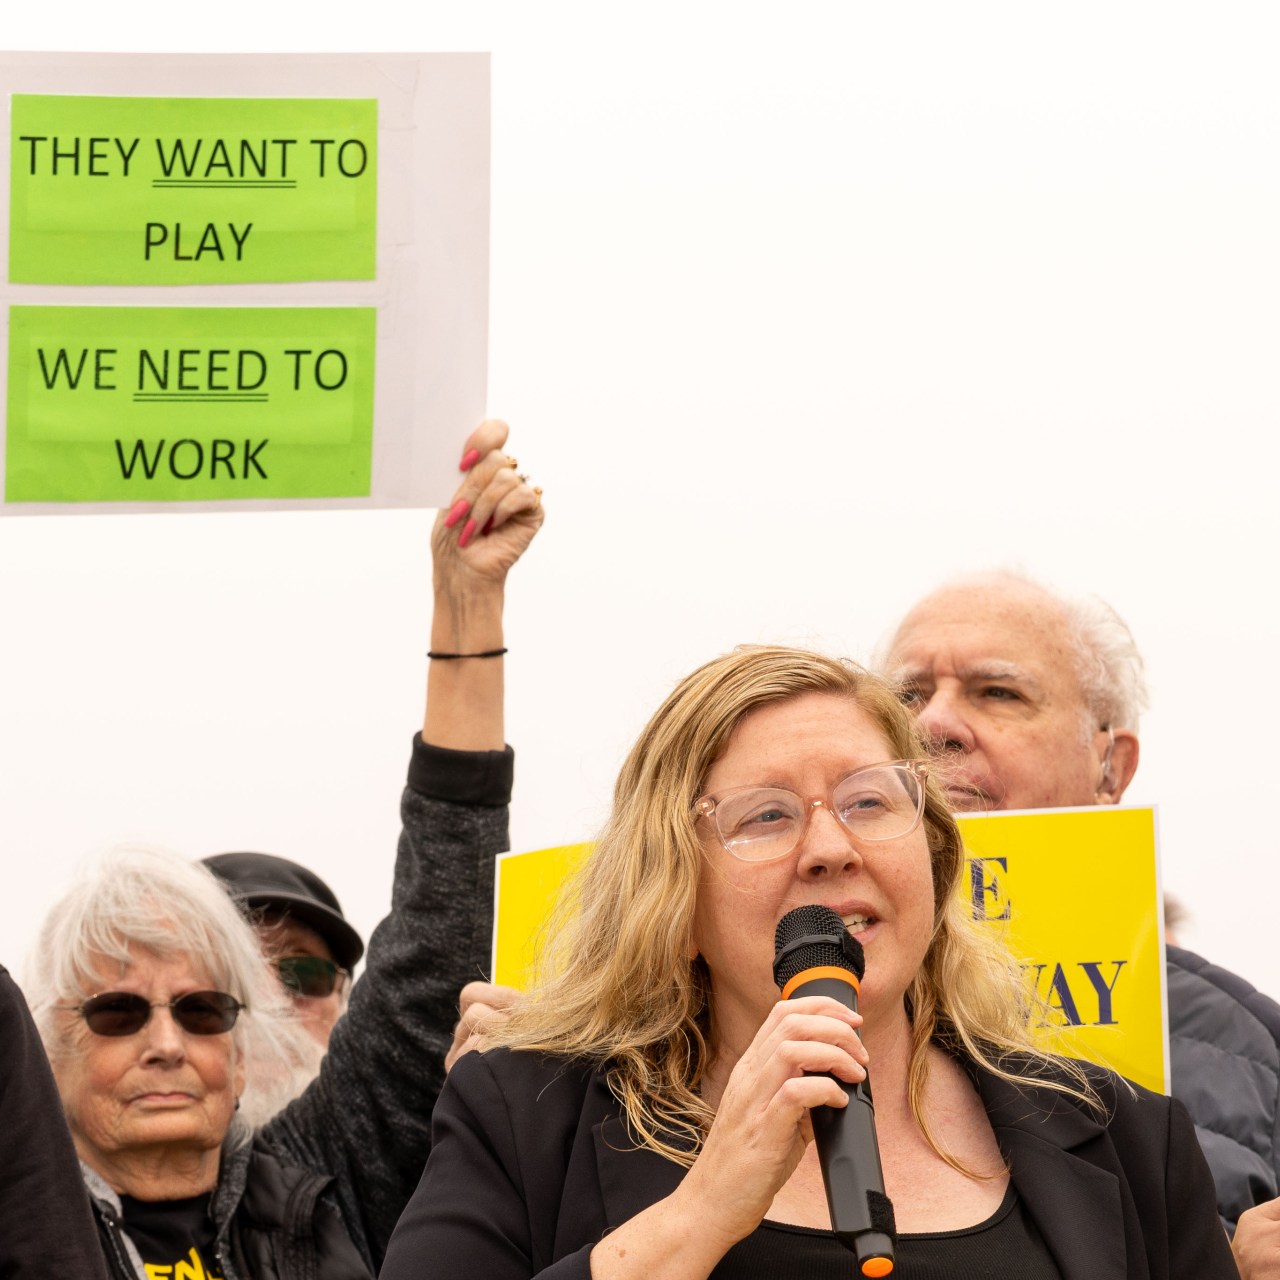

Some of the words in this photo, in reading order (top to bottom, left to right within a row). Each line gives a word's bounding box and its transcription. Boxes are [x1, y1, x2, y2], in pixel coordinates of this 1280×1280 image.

[20, 137, 139, 176] THEY
[154, 139, 296, 178] WANT
[311, 140, 366, 177] TO
[145, 223, 252, 261] PLAY
[38, 349, 116, 389] WE
[139, 350, 266, 390] NEED
[285, 350, 347, 390] TO
[115, 439, 268, 479] WORK
